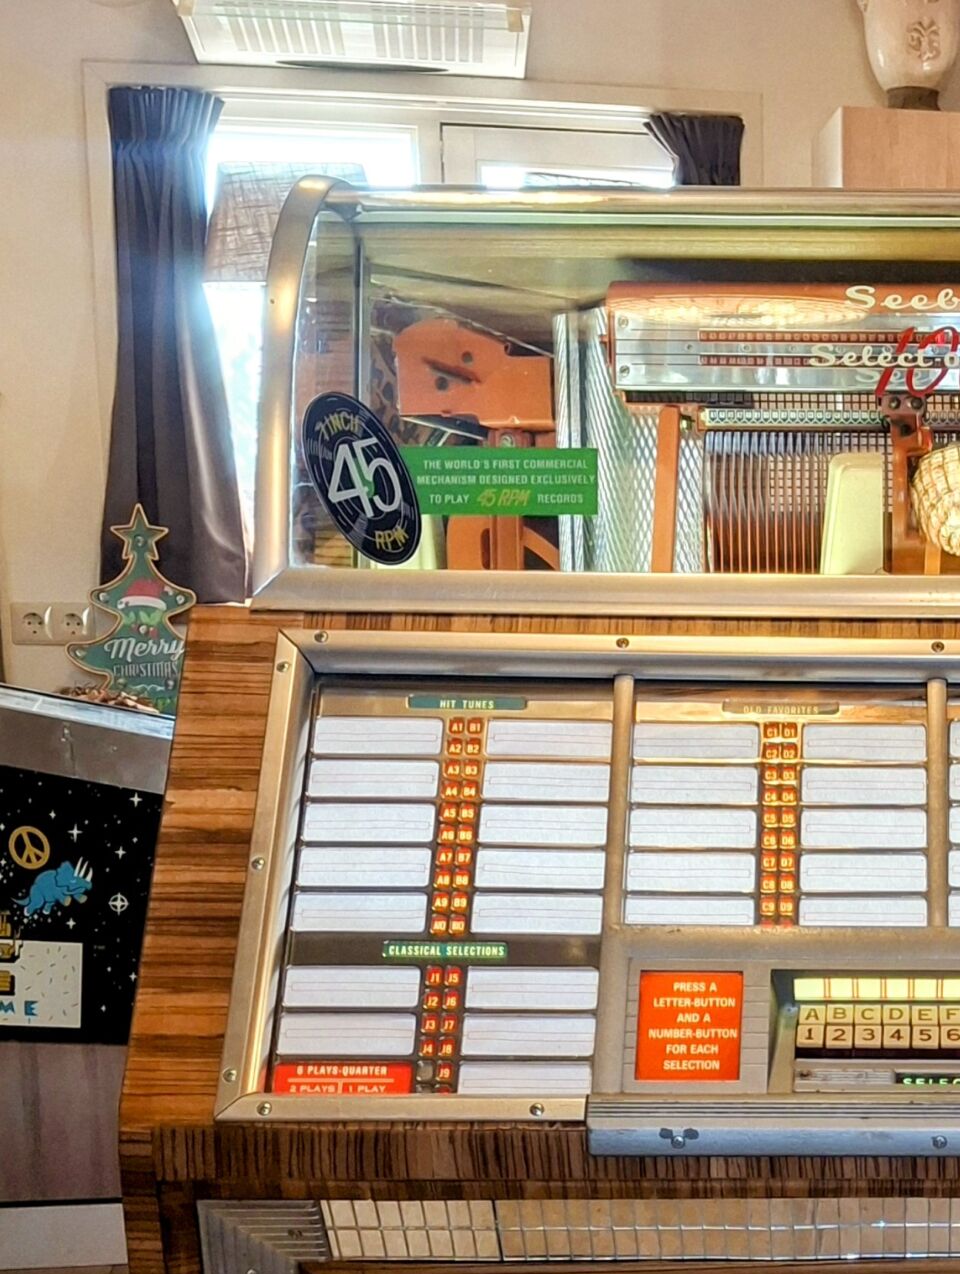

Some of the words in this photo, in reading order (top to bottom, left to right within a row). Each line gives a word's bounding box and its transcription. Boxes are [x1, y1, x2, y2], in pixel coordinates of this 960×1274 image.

[424, 460, 441, 470] THE
[493, 460, 520, 469] FIRST
[524, 459, 588, 469] COMMERCIAL
[328, 437, 402, 518] 45
[417, 476, 476, 485] MECHANISM
[479, 475, 528, 485] DESIGNED
[531, 475, 595, 485] EXCLUSIVELY
[429, 495, 441, 504] TO
[444, 494, 469, 504] PLAY
[477, 489, 496, 507] 45
[498, 489, 531, 507] RPM
[537, 494, 583, 504] RECORDS
[375, 521, 410, 551] RPM
[104, 637, 187, 662] Merry
[113, 661, 179, 677] CHRISTMAS
[440, 700, 455, 709] HIT
[462, 700, 494, 709] TUNES
[767, 705, 819, 714] FAVORITES
[452, 723, 463, 731] A1
[469, 723, 480, 732] B1
[767, 728, 777, 737] C1
[449, 744, 461, 753] A2
[467, 744, 479, 753] B2
[766, 749, 777, 759] C2
[447, 766, 460, 775] A3
[465, 766, 478, 775] B3
[445, 787, 458, 796] A4
[463, 787, 476, 796] B4
[443, 808, 456, 818] A5
[461, 808, 474, 818] B5
[440, 853, 453, 863] A7
[389, 946, 441, 956] CLASSICAL
[446, 945, 505, 956] SELECTIONS
[430, 973, 440, 983] J1
[448, 973, 459, 983] J5
[673, 982, 706, 992] PRESS
[709, 982, 717, 992] A
[427, 996, 439, 1005] J2
[446, 996, 456, 1006] J6
[653, 997, 736, 1008] LETTER-BUTTON
[676, 1013, 700, 1023] AND
[703, 1013, 711, 1023] A
[805, 1008, 819, 1020] A
[833, 1008, 847, 1019] B
[861, 1008, 875, 1020] C
[889, 1008, 904, 1020] D
[918, 1009, 932, 1021] E
[945, 1008, 960, 1020] F
[425, 1020, 436, 1030] J3
[444, 1020, 454, 1030] J7
[648, 1028, 737, 1039] NUMBER-BUTTON
[804, 1028, 814, 1040] 1
[831, 1029, 847, 1041] 2
[862, 1029, 875, 1041] 3
[889, 1028, 904, 1041] 4
[919, 1029, 932, 1041] 5
[422, 1044, 433, 1053] J4
[441, 1044, 452, 1053] J8
[666, 1044, 687, 1054] FOR
[690, 1044, 719, 1054] EACH
[663, 1060, 720, 1070] SELECTION
[439, 1068, 450, 1078] J9
[290, 1085, 296, 1093] 2
[300, 1085, 336, 1093] PLAYS
[357, 1085, 386, 1093] PLAY
